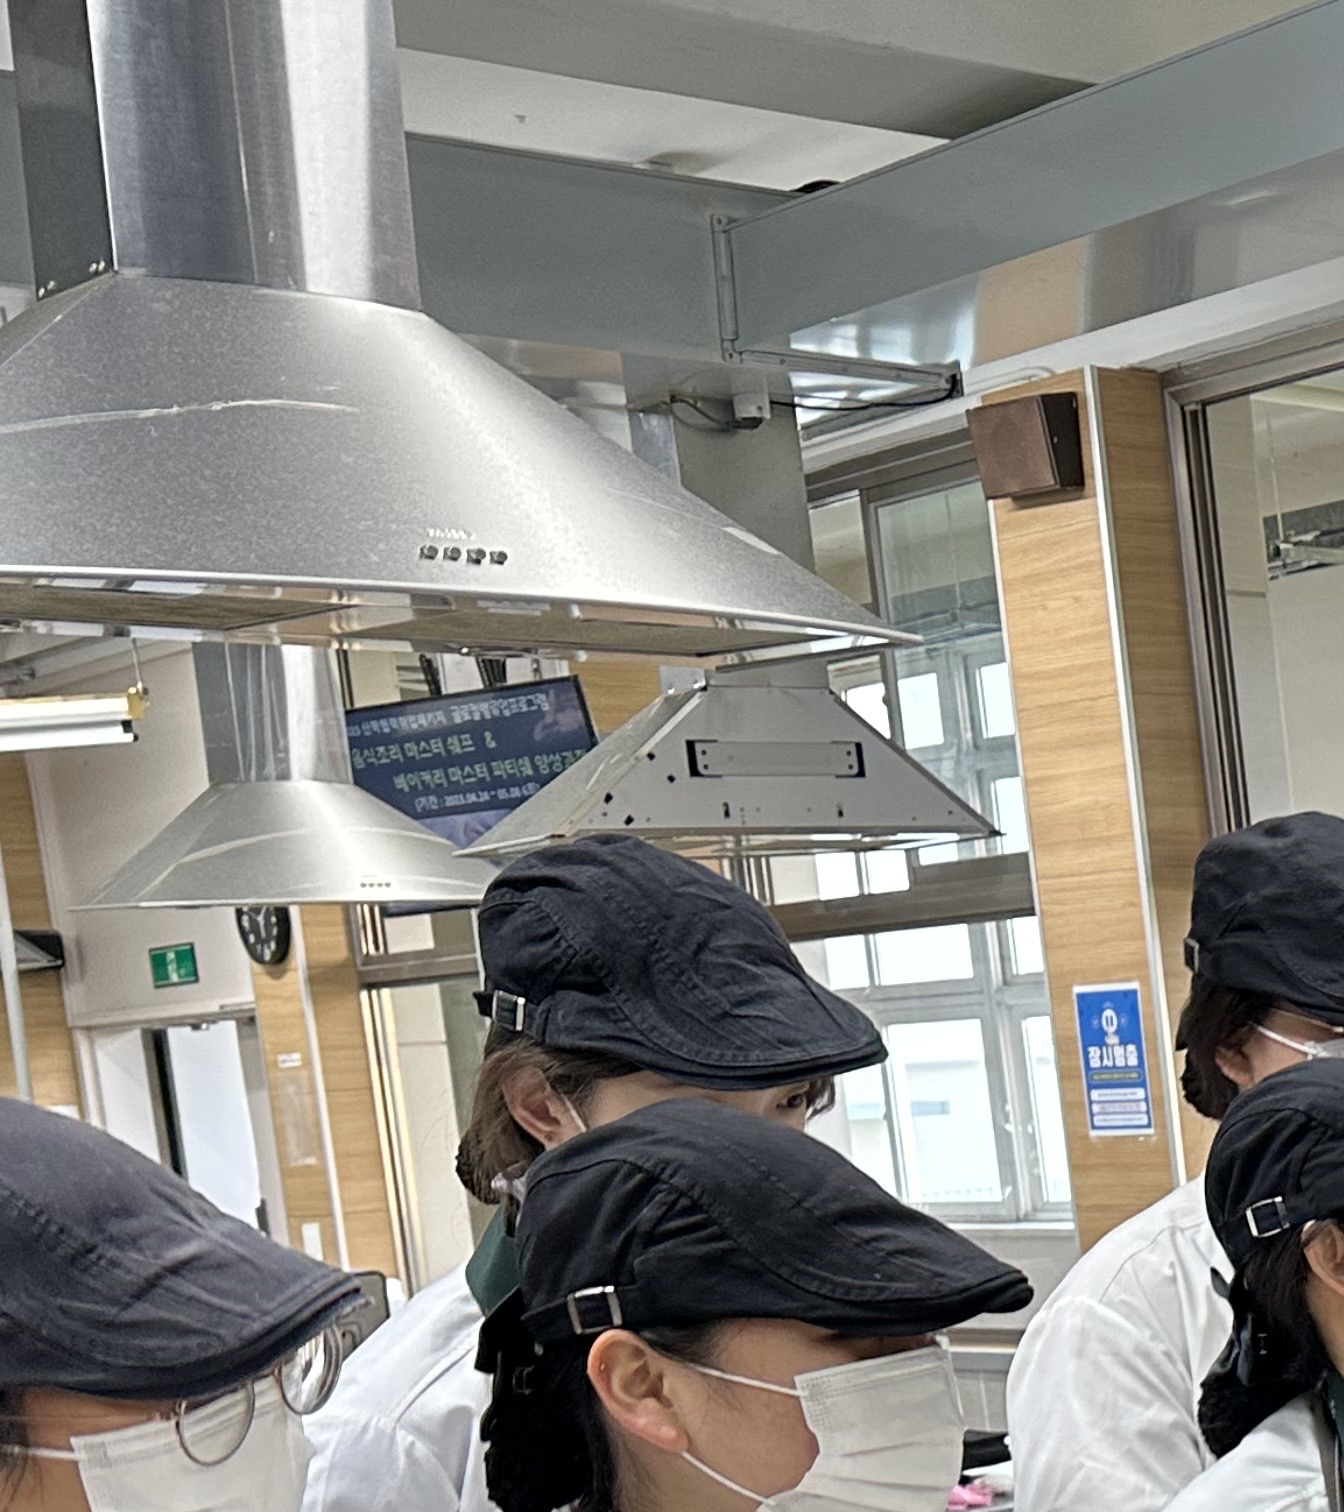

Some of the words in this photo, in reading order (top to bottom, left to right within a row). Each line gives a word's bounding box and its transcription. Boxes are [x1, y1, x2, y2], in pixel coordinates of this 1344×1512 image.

[403, 738, 447, 761] 마스터
[484, 730, 497, 749] &
[447, 761, 490, 784] 마스터
